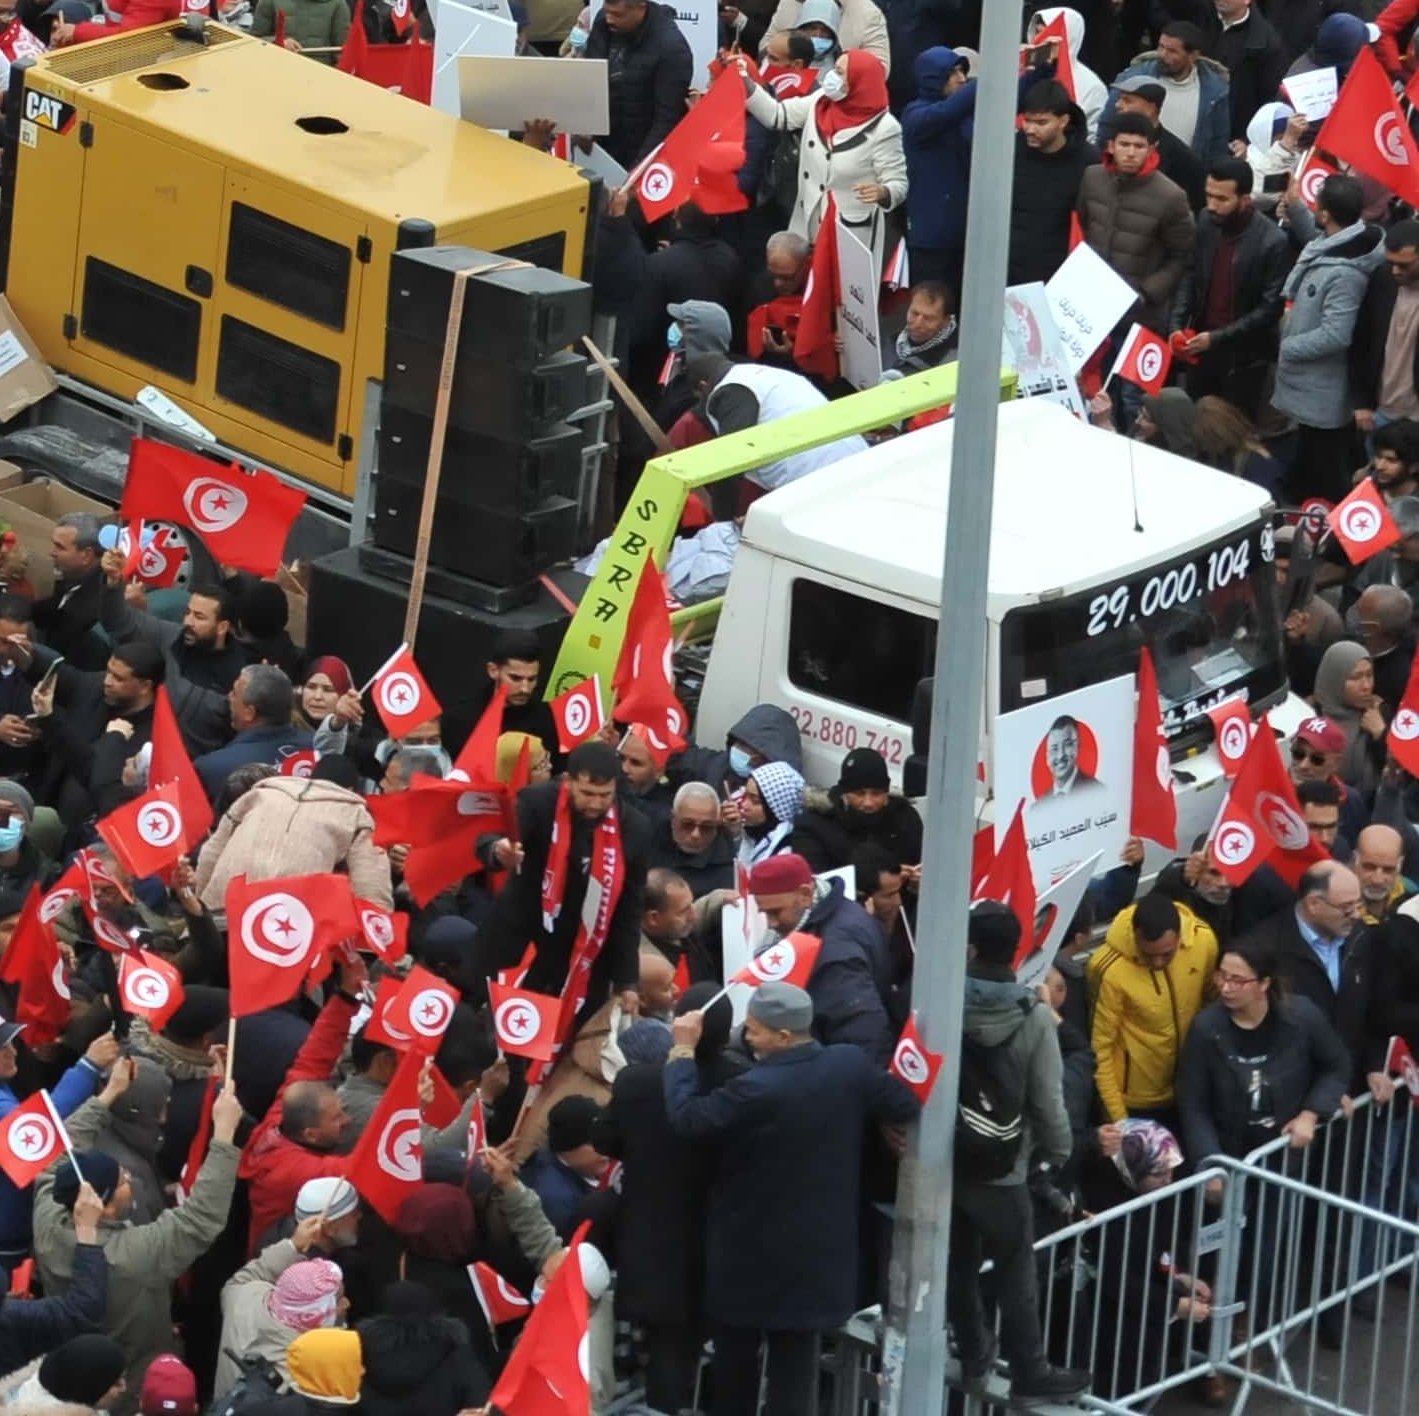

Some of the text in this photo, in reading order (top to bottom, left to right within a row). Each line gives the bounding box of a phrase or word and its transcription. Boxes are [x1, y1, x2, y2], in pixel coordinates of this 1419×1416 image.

[26, 91, 63, 131] CAT
[1086, 539, 1249, 637] 29.000.104
[866, 730, 902, 765] 742
